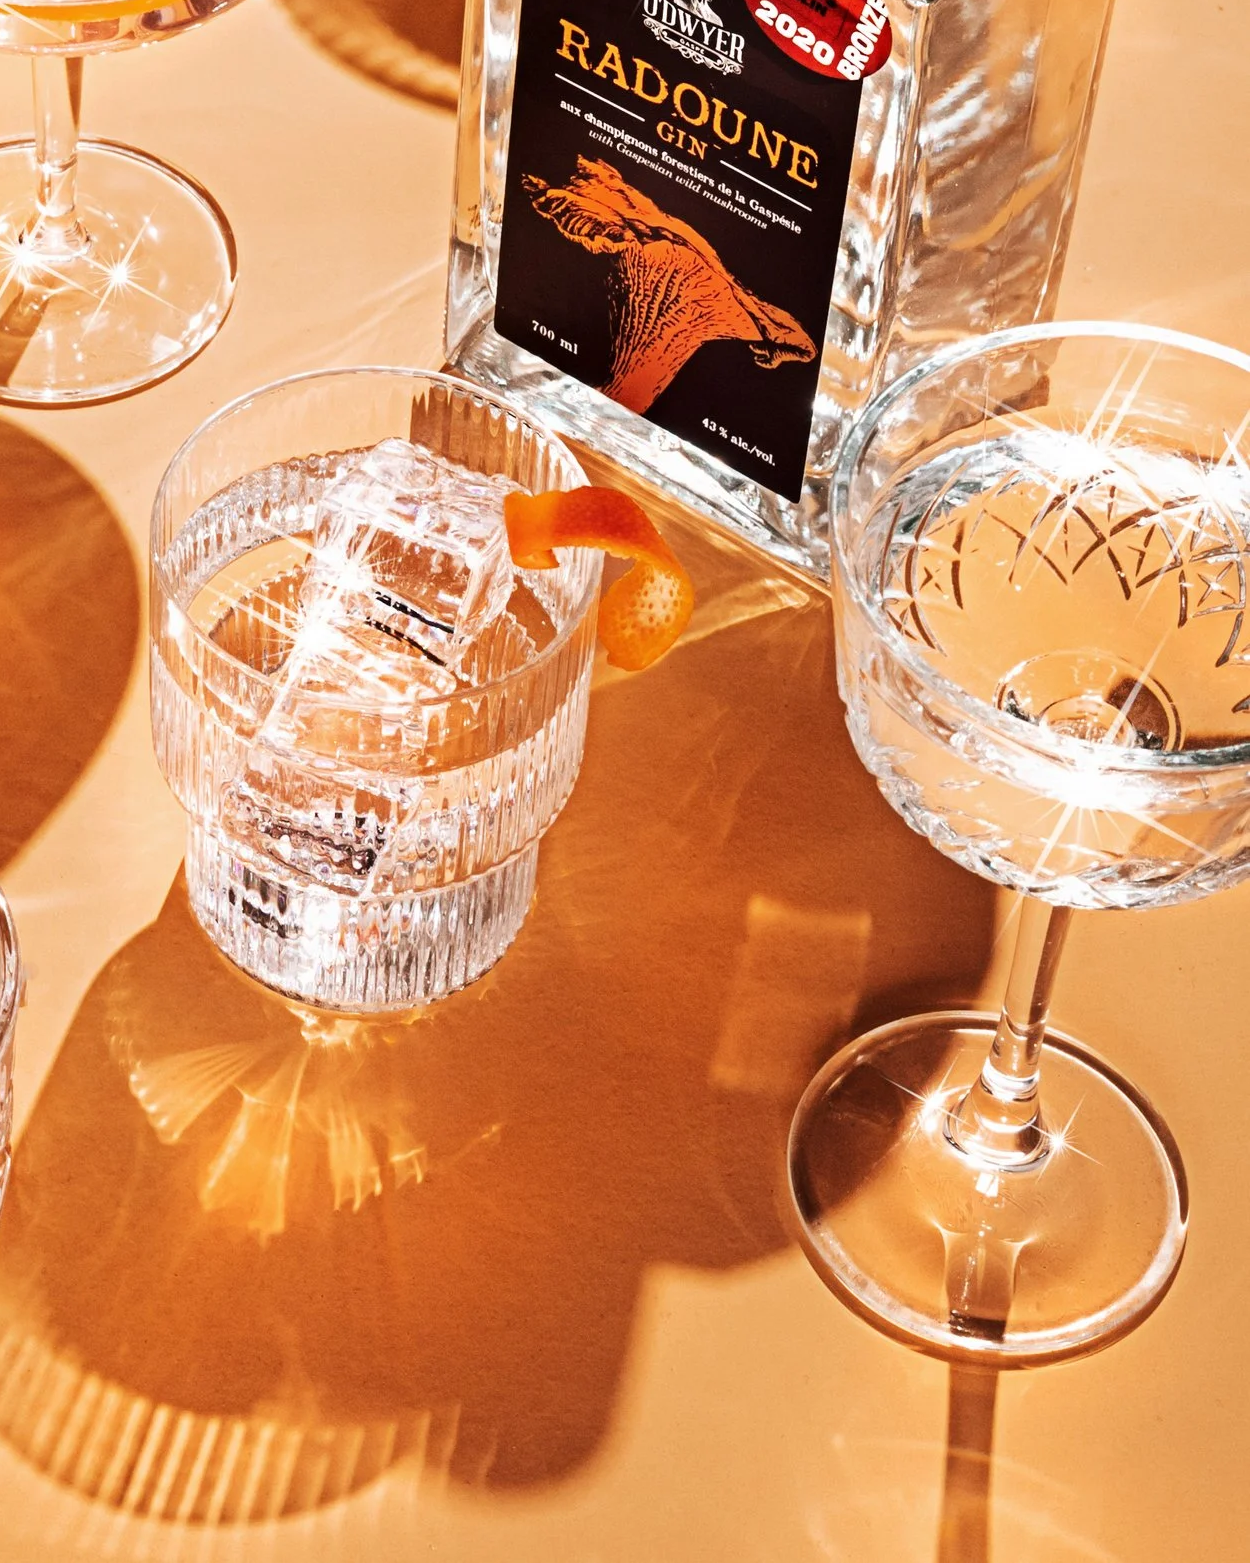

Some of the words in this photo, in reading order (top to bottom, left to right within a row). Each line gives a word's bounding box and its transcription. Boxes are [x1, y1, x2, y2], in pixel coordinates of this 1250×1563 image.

[755, 0, 835, 66] 2020
[556, 19, 818, 189] RADOUNE
[560, 100, 582, 117] aux
[584, 112, 659, 157] champignons
[661, 151, 715, 187] forestiers
[717, 183, 732, 197] de
[735, 190, 746, 205] la
[749, 199, 802, 235] Gaspésie
[656, 121, 708, 161] GIN
[588, 129, 613, 148] with
[616, 142, 673, 179] Gaspesian
[675, 173, 702, 194] wild
[702, 189, 768, 230] mushrooms
[532, 319, 555, 341] 700
[559, 337, 578, 356] ml
[702, 417, 717, 432] 43
[718, 426, 728, 439] %
